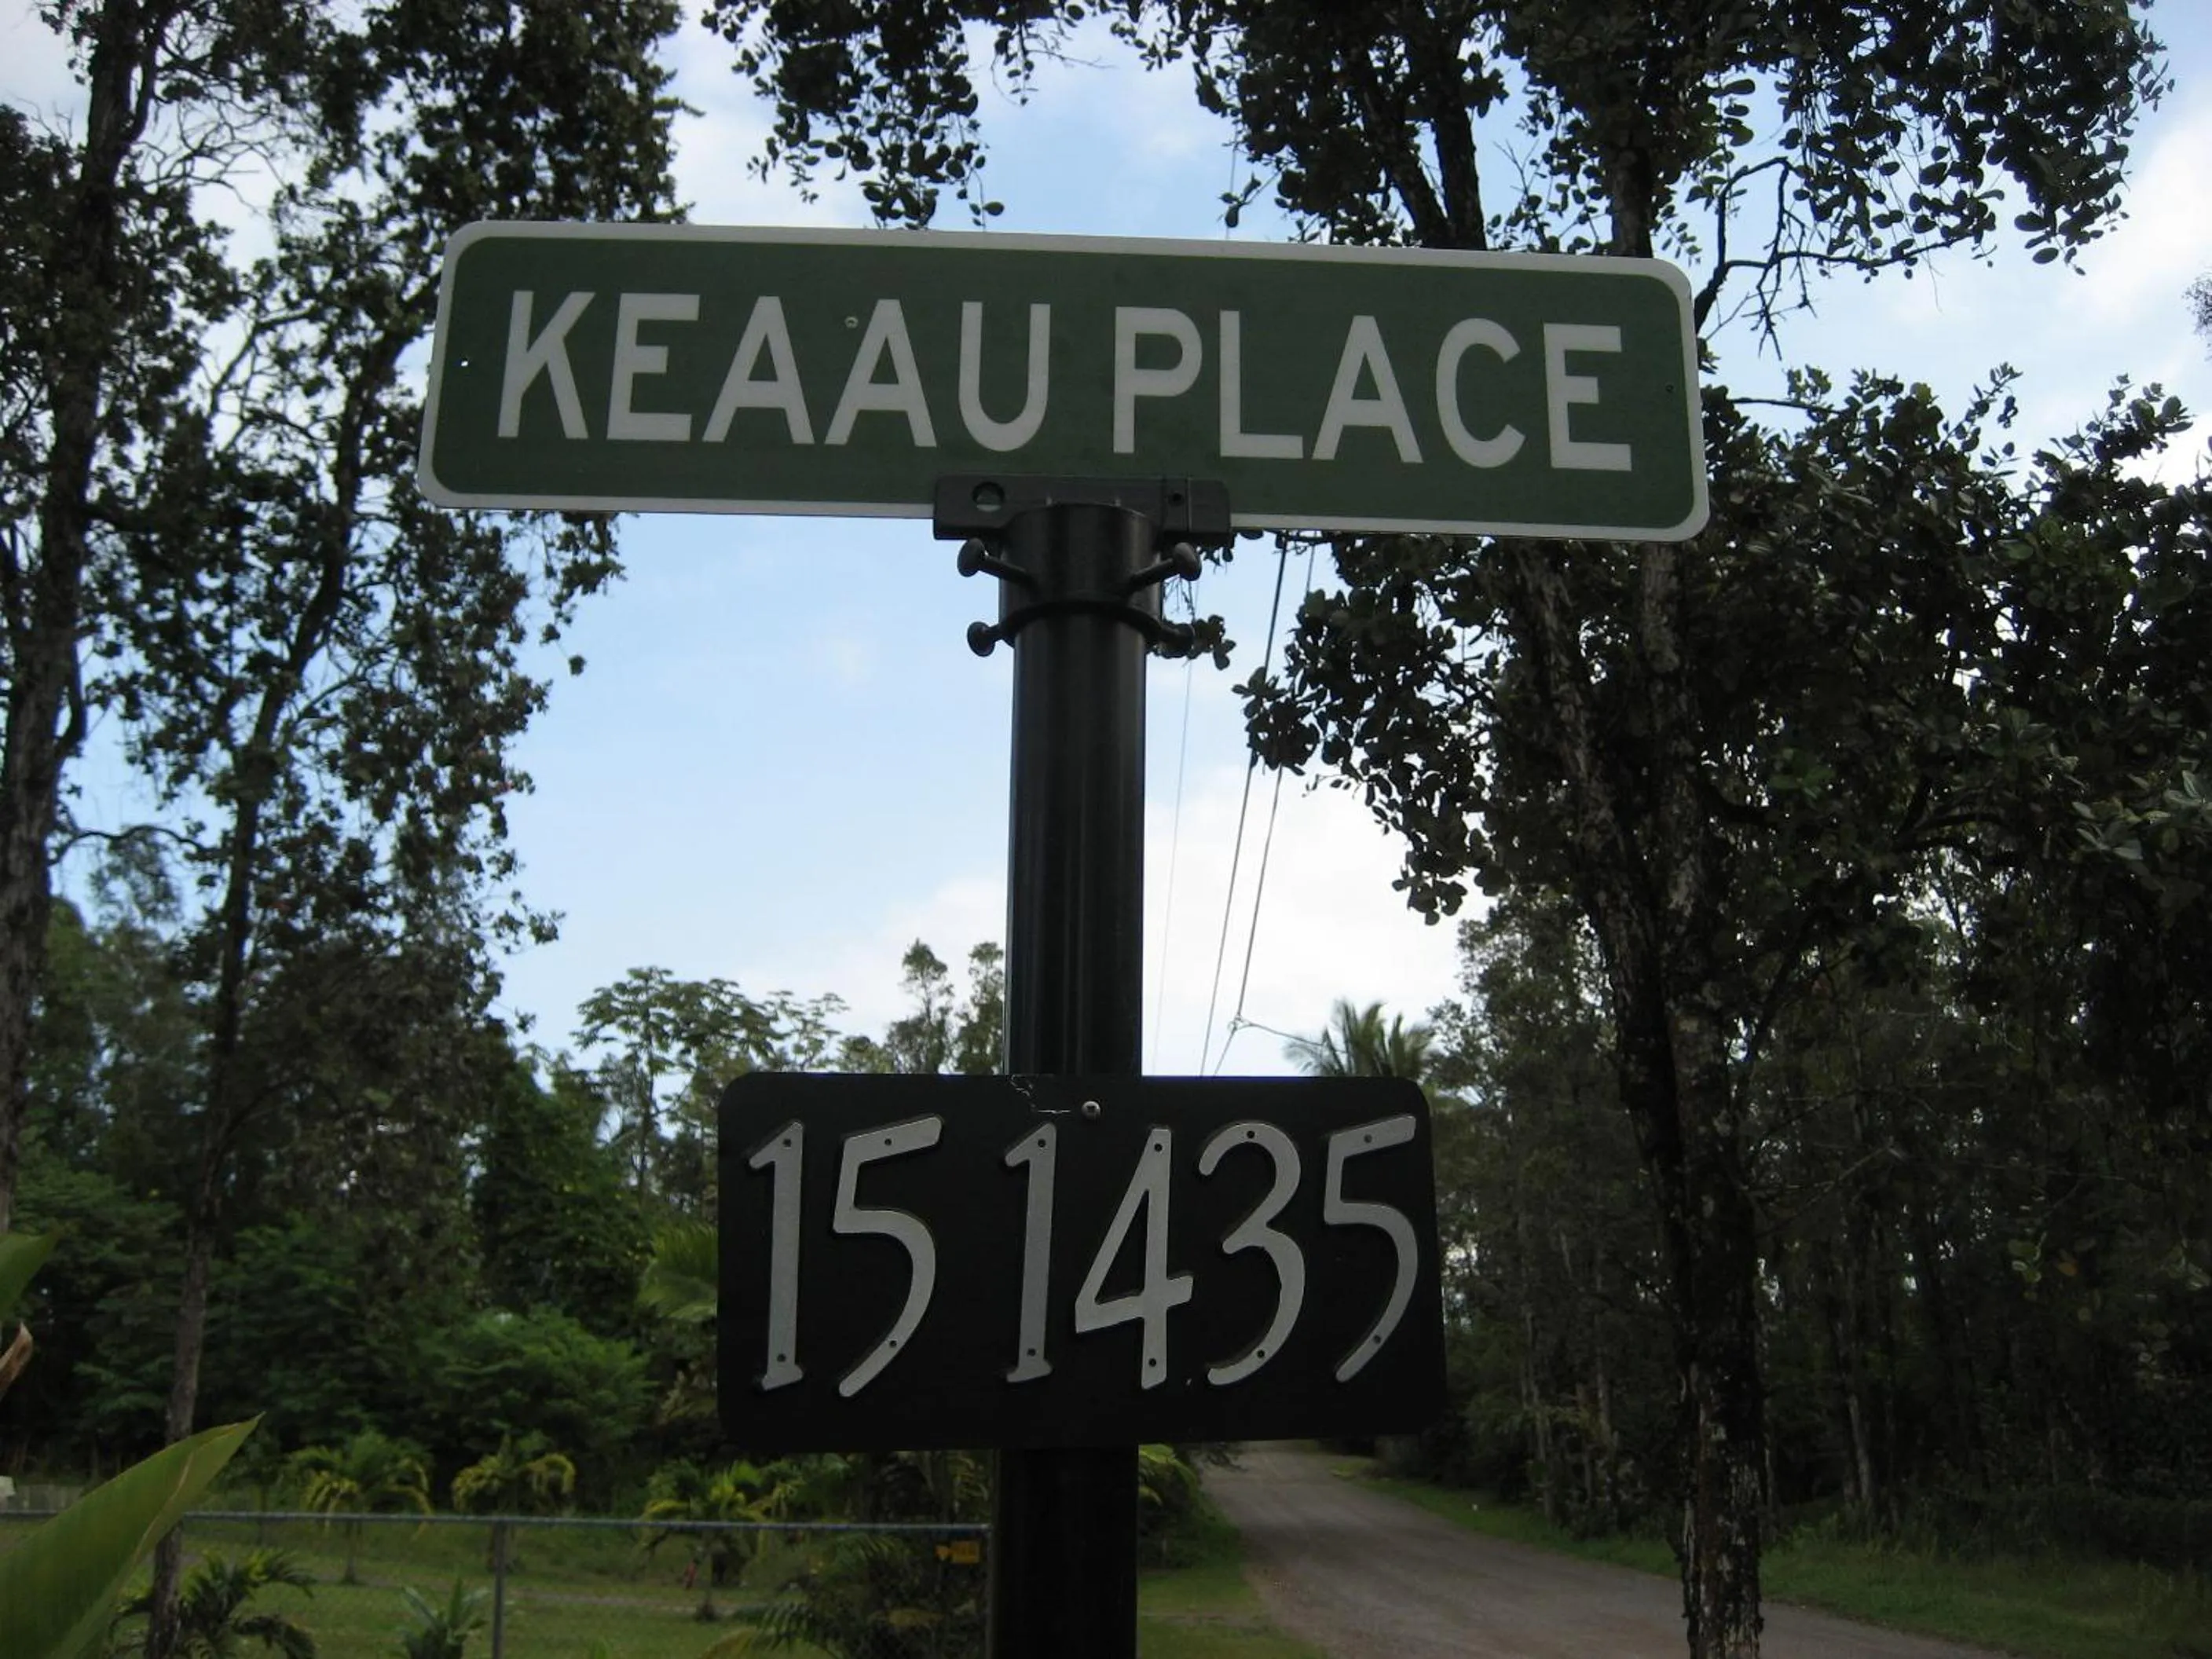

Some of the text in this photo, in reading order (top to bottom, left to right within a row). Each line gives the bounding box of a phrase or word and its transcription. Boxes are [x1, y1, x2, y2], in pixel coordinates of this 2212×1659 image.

[496, 290, 1632, 471] KEAAU PLACE
[748, 1115, 1419, 1398] 15 1435
